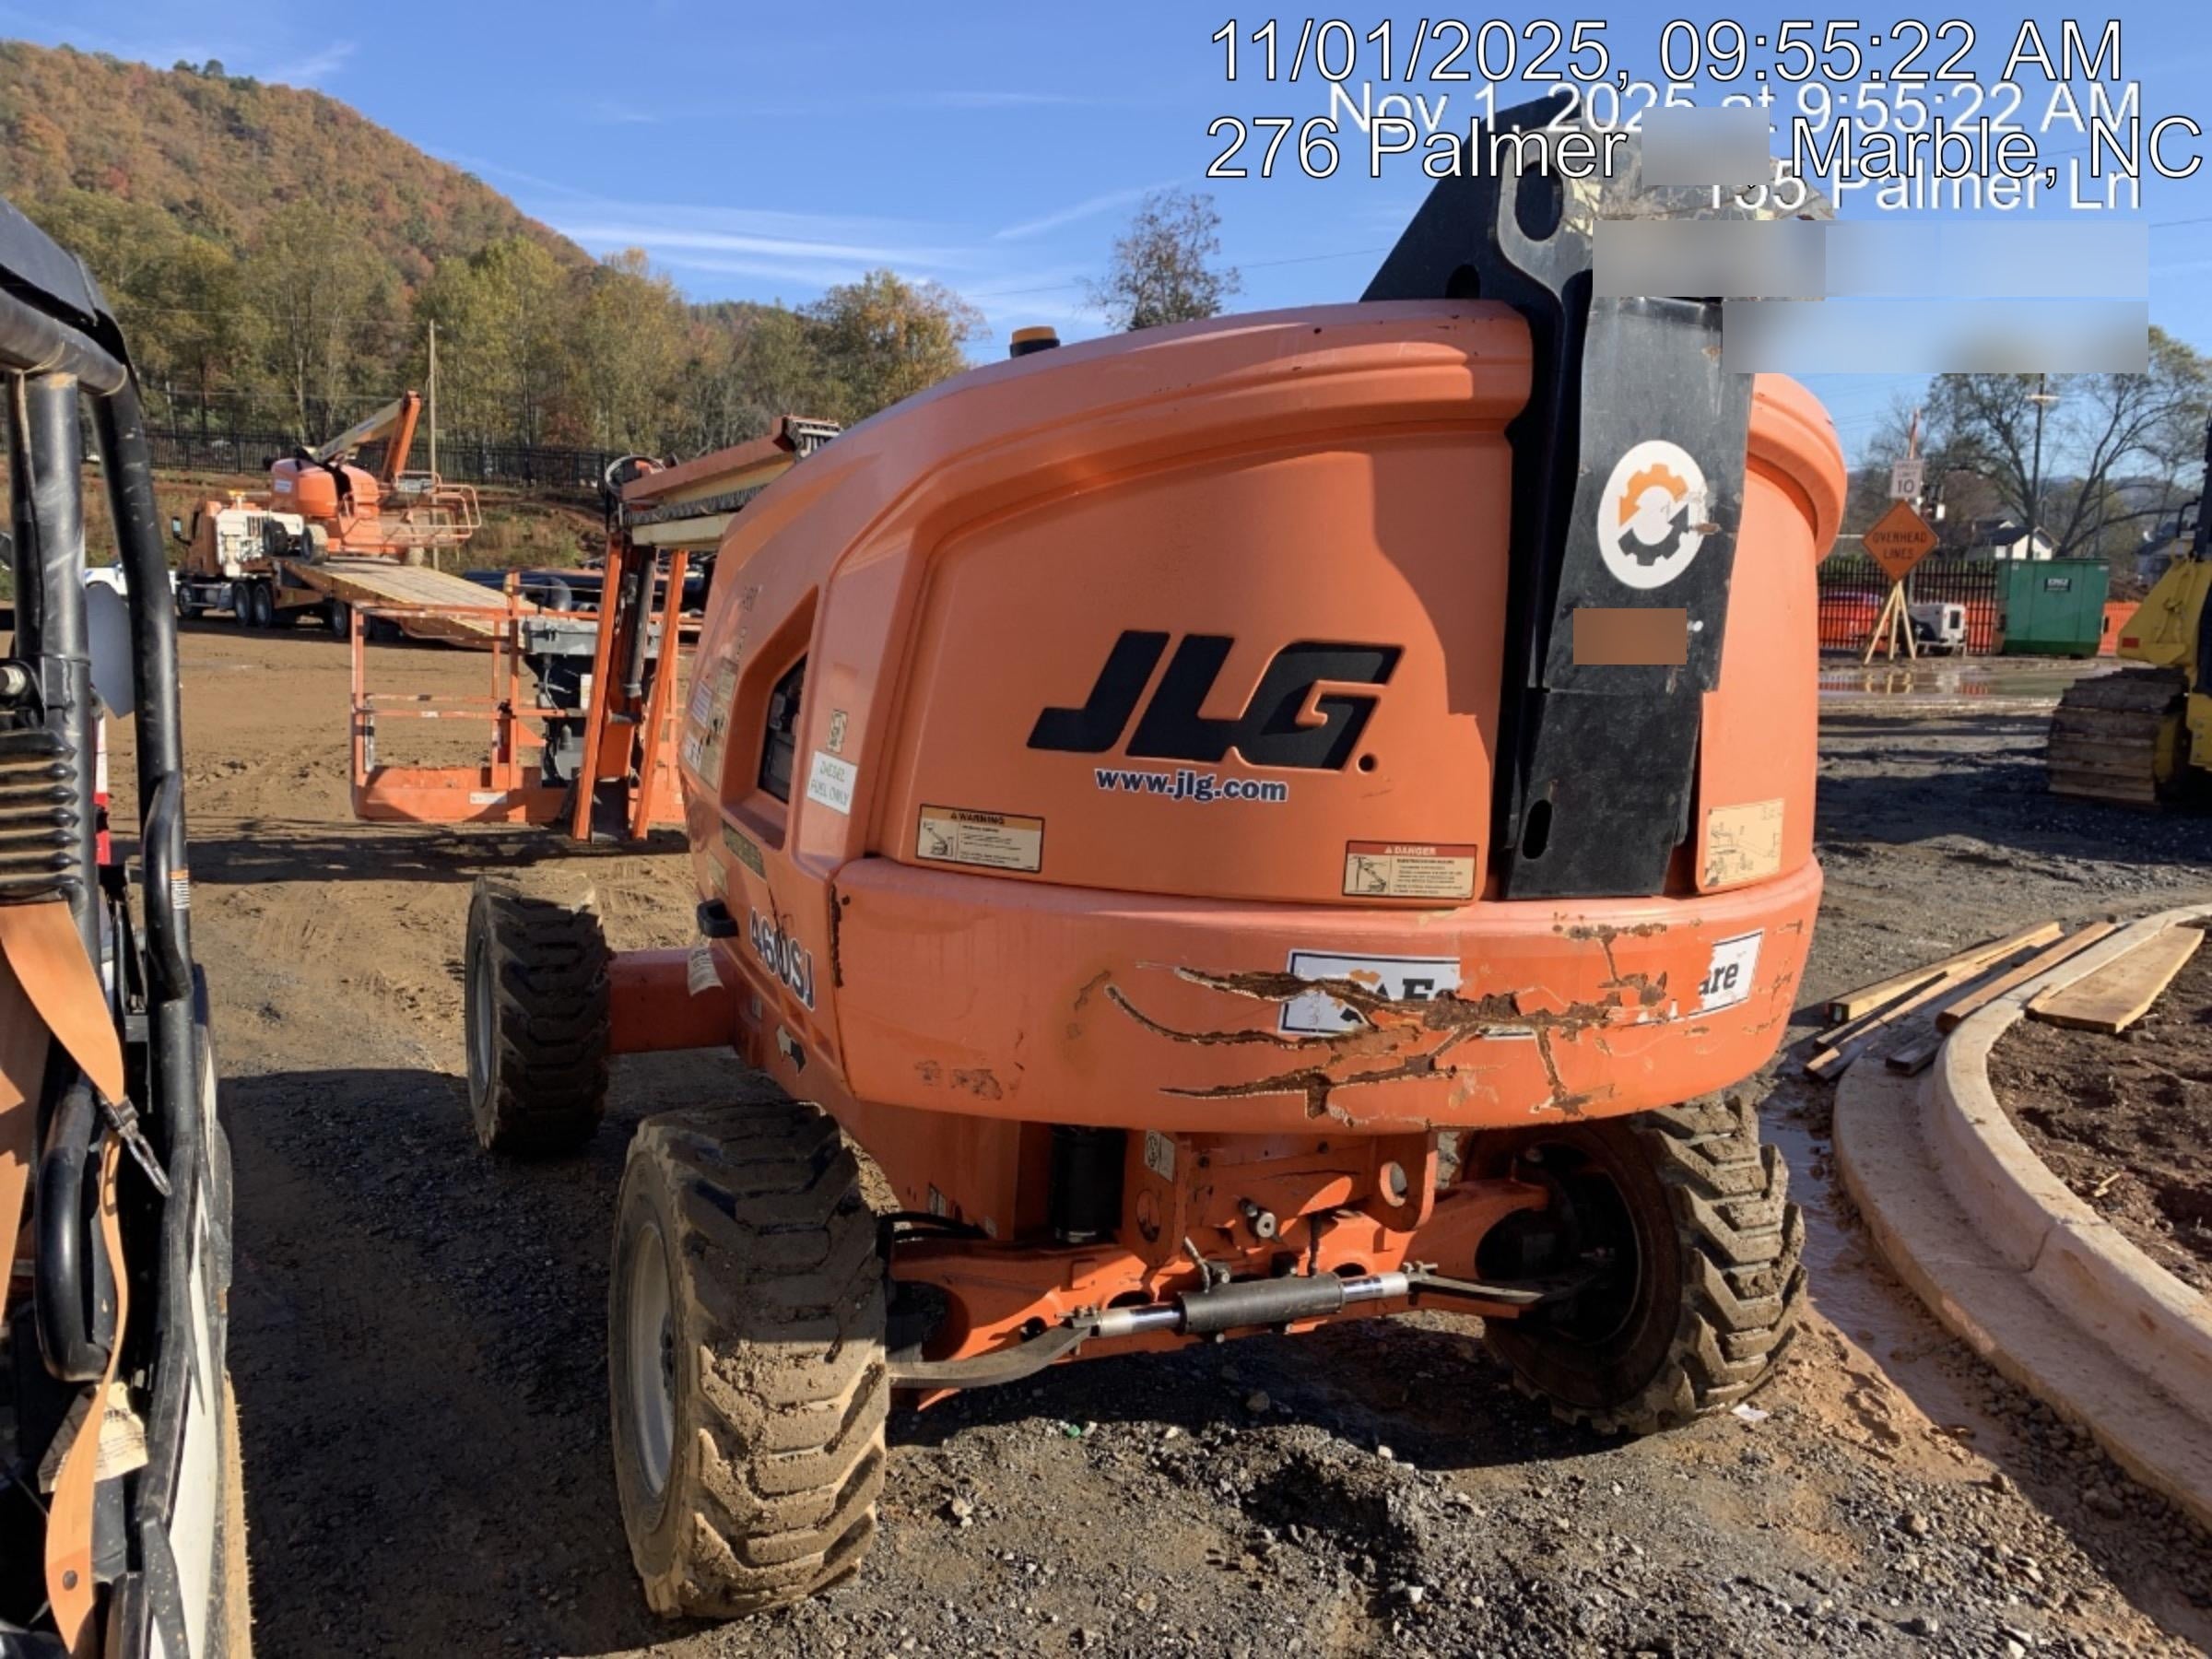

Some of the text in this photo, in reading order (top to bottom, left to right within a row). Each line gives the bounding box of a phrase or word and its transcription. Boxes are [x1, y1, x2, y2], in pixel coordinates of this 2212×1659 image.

[1872, 530, 1927, 545] OVERHEAD
[1026, 629, 1405, 771] JLG
[1094, 768, 1288, 803] www.jlg.com
[959, 812, 1006, 826] WARNING
[1394, 846, 1437, 855] DANGER
